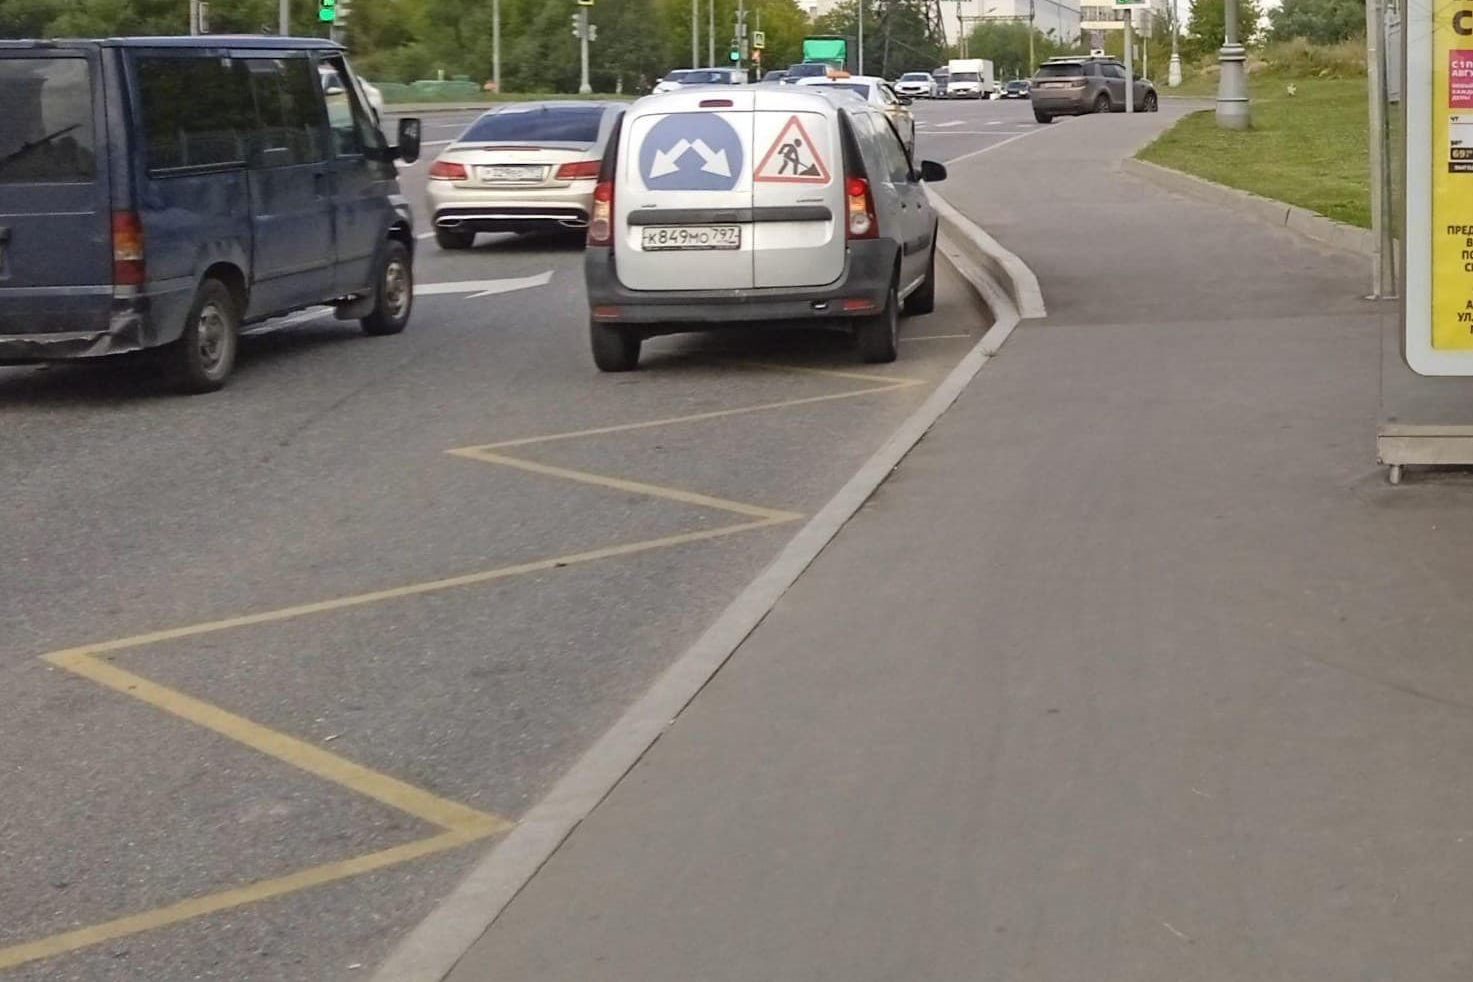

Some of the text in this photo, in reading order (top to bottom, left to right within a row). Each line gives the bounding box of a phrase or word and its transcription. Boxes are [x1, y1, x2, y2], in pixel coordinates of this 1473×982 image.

[1452, 61, 1458, 69] С
[712, 228, 736, 240] 797
[1466, 238, 1473, 248] В
[1457, 312, 1473, 322] УЛ.
